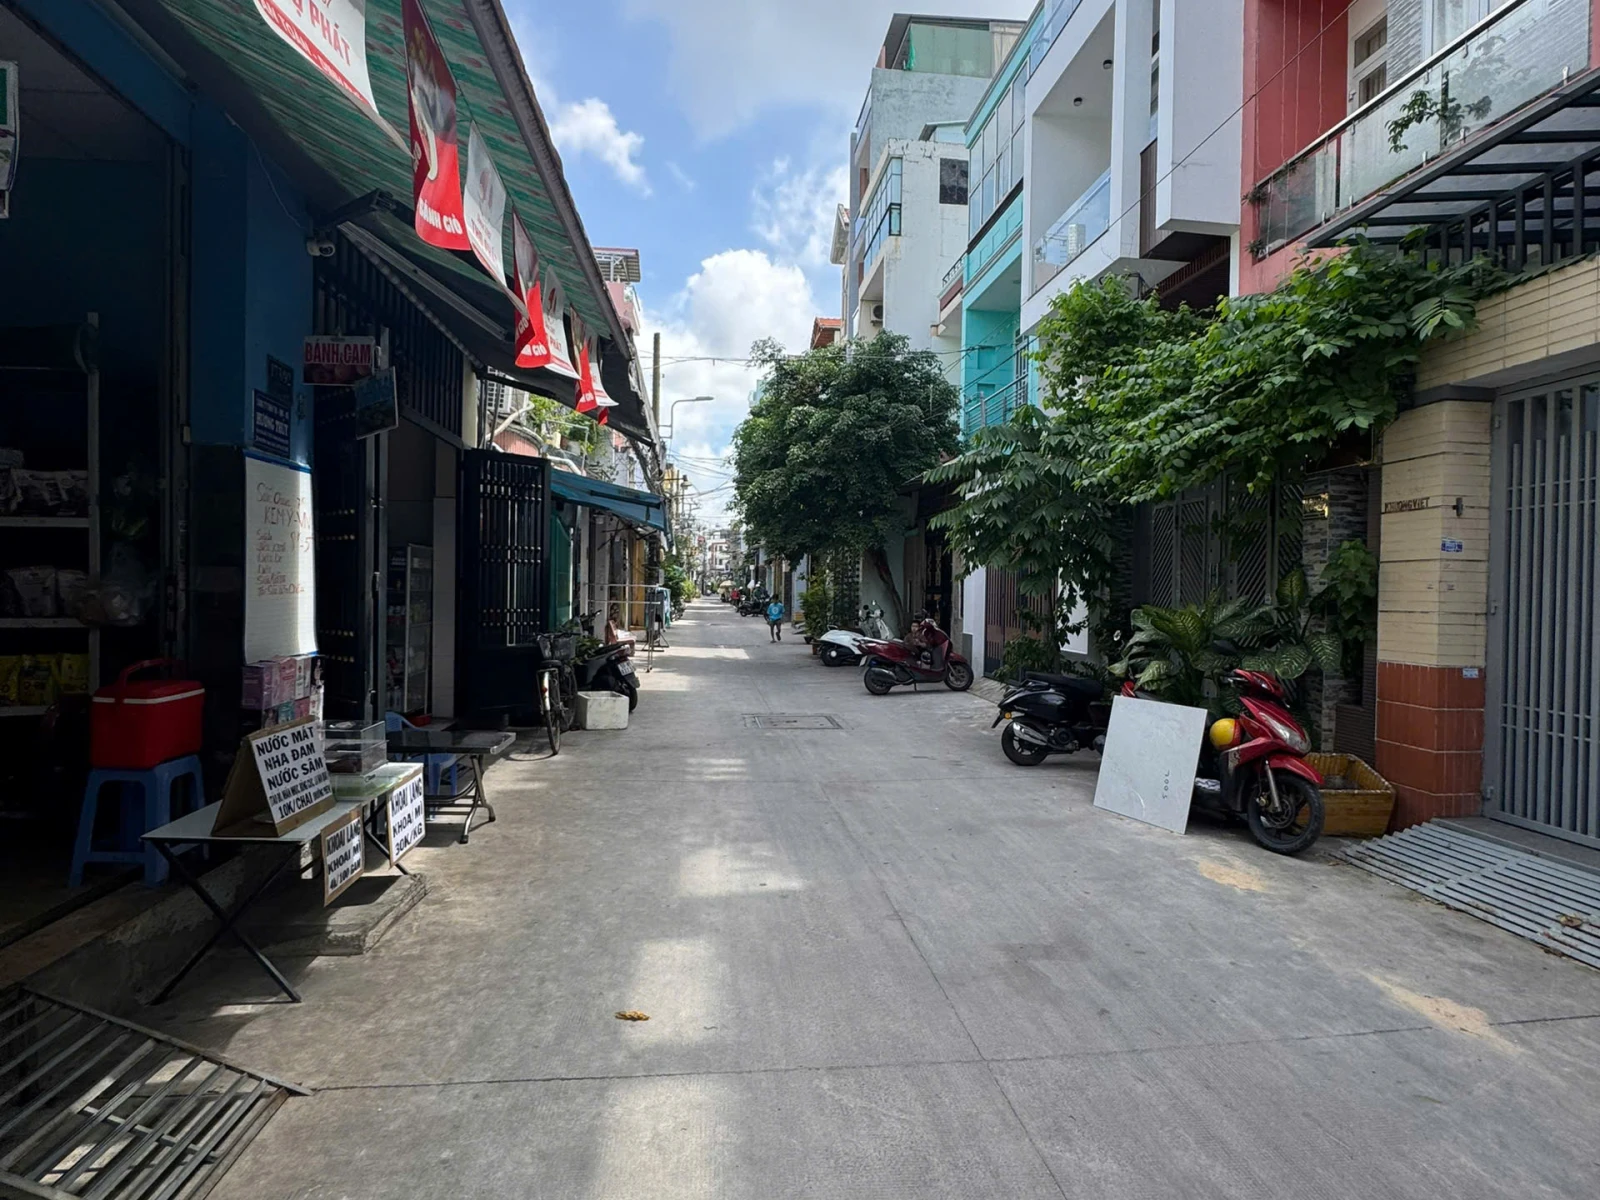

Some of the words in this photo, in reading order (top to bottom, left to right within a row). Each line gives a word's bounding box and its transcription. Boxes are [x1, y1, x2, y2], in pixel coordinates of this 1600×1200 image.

[305, 338, 340, 364] BÁNH
[344, 343, 372, 365] CAM
[256, 734, 289, 757] NƯỚC
[291, 725, 315, 745] MÁT
[264, 752, 290, 772] NHA
[291, 742, 316, 761] ĐAM
[267, 767, 299, 790] NƯỚC
[301, 757, 324, 775] SÂM
[279, 791, 314, 819] 10K/CHAI
[392, 811, 414, 838] KHOAI
[395, 822, 423, 857] 30K/KG
[327, 849, 351, 875] KHOAI
